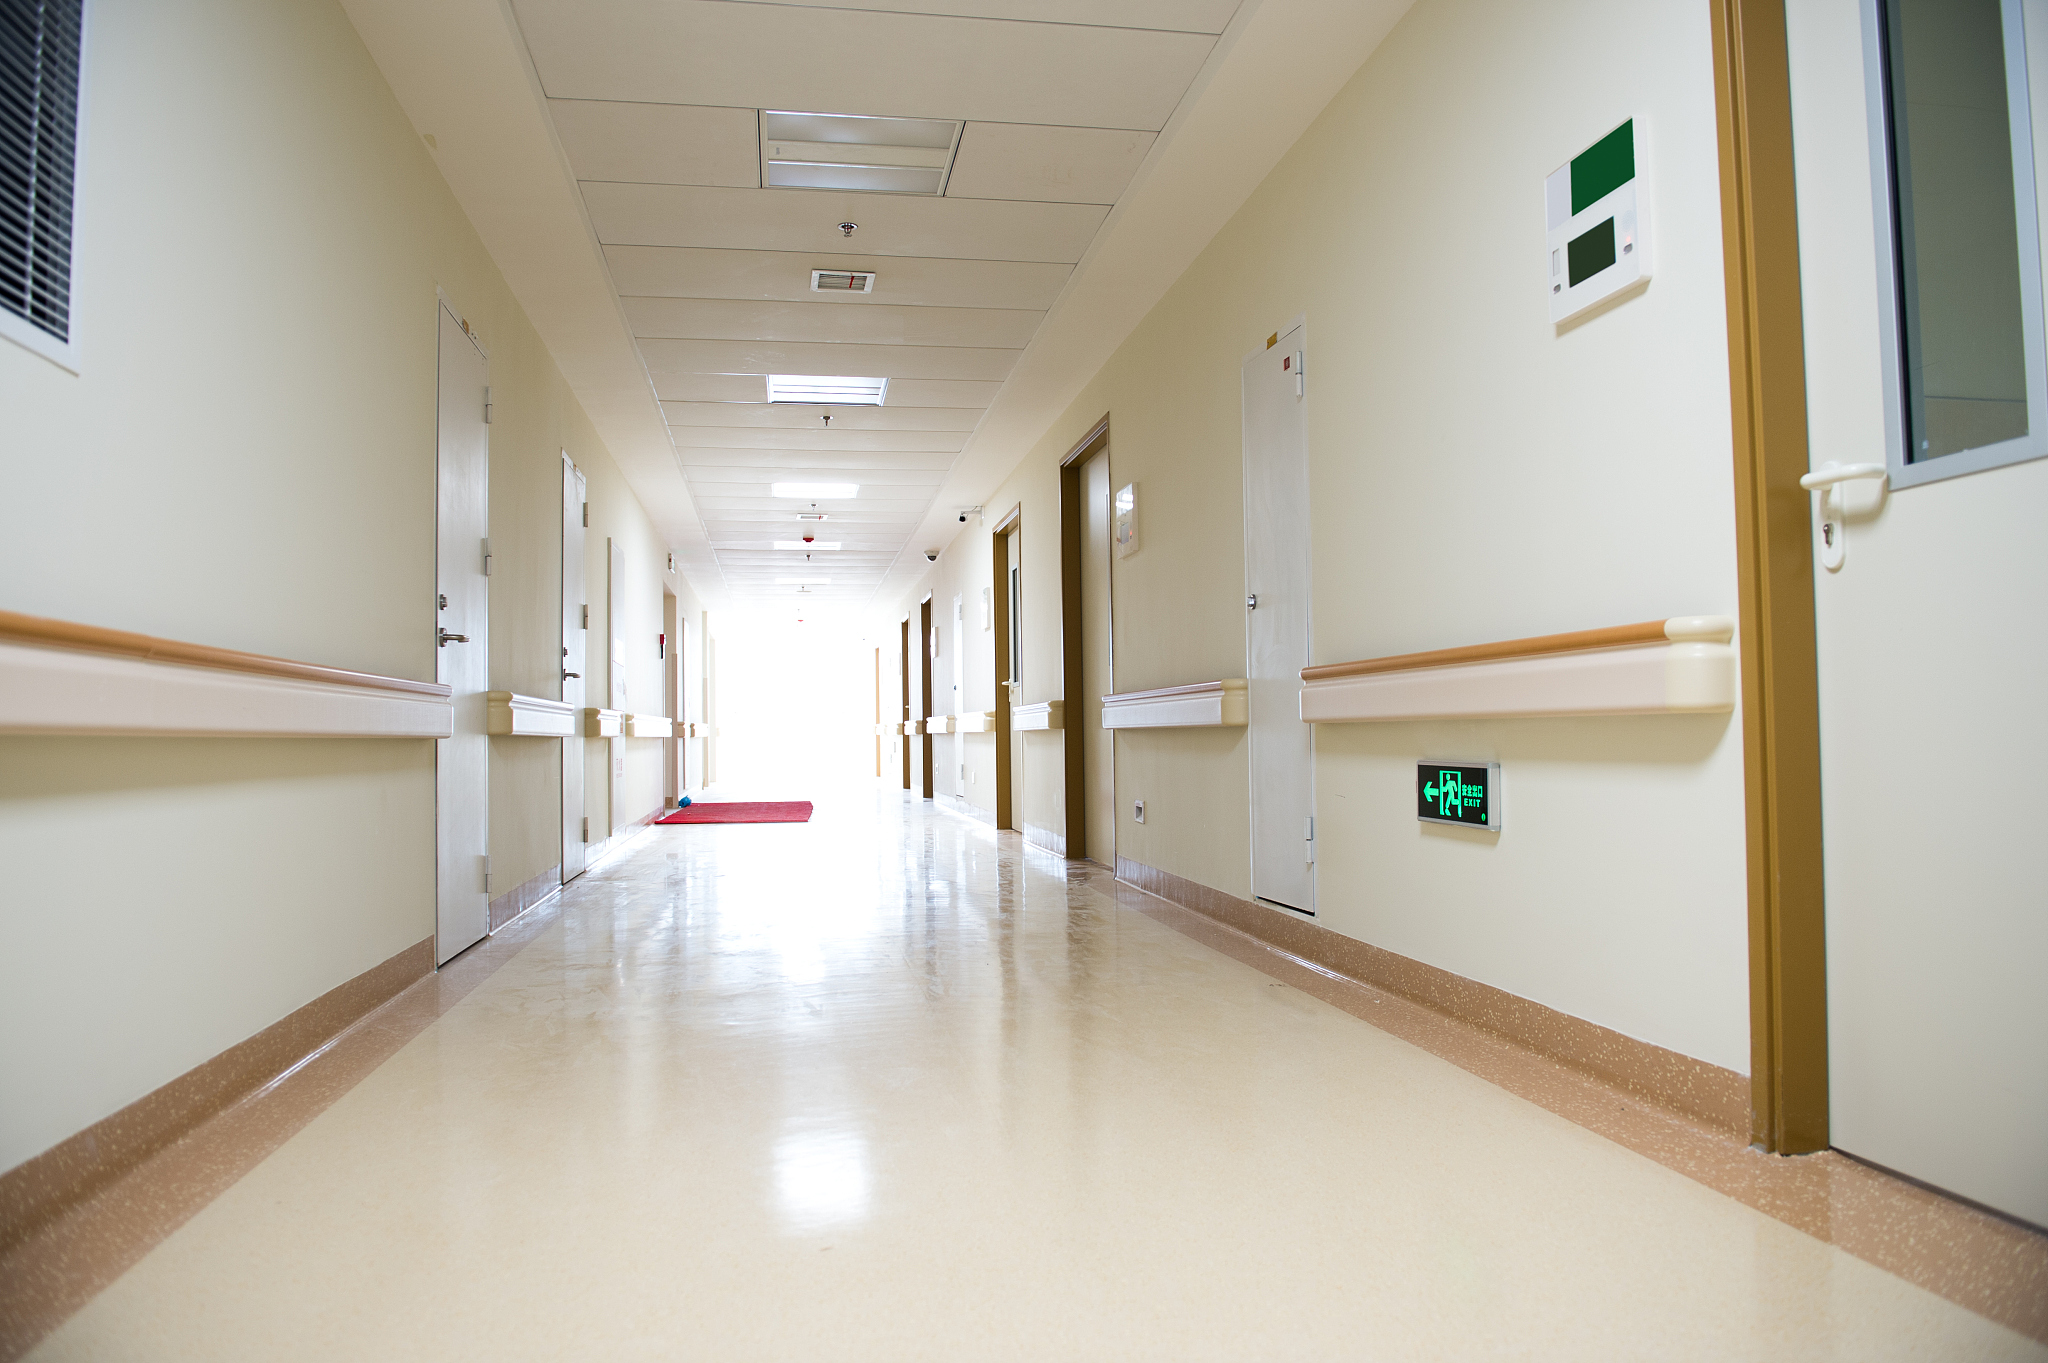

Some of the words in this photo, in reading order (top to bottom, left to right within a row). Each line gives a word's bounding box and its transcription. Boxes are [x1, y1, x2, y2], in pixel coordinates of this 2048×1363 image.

[1462, 784, 1483, 798] 安全出口
[1464, 798, 1481, 807] EXIT
